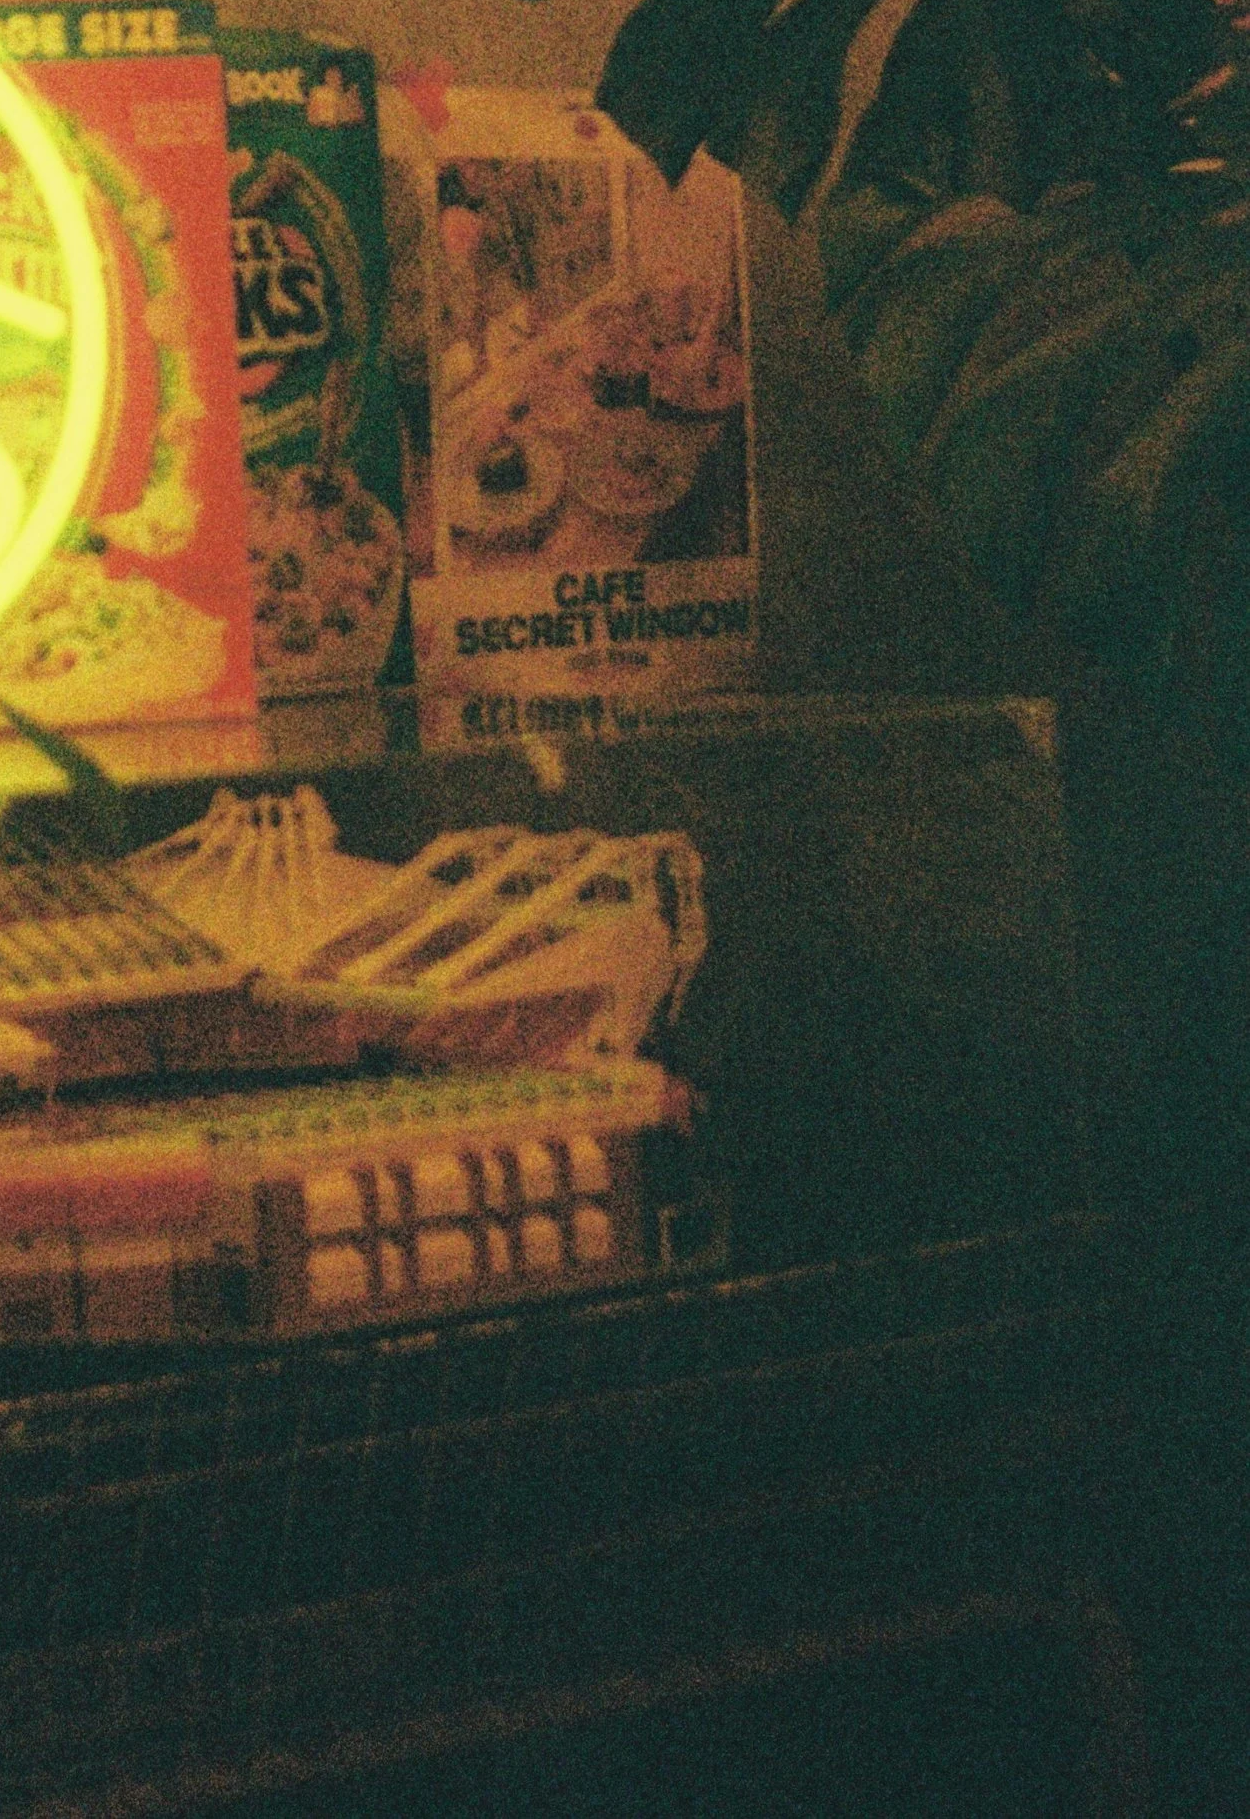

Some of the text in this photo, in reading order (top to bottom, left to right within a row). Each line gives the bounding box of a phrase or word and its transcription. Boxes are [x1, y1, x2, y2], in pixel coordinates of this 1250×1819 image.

[79, 9, 181, 55] SIZE
[552, 569, 647, 608] CAFE
[456, 610, 596, 656] SECRET
